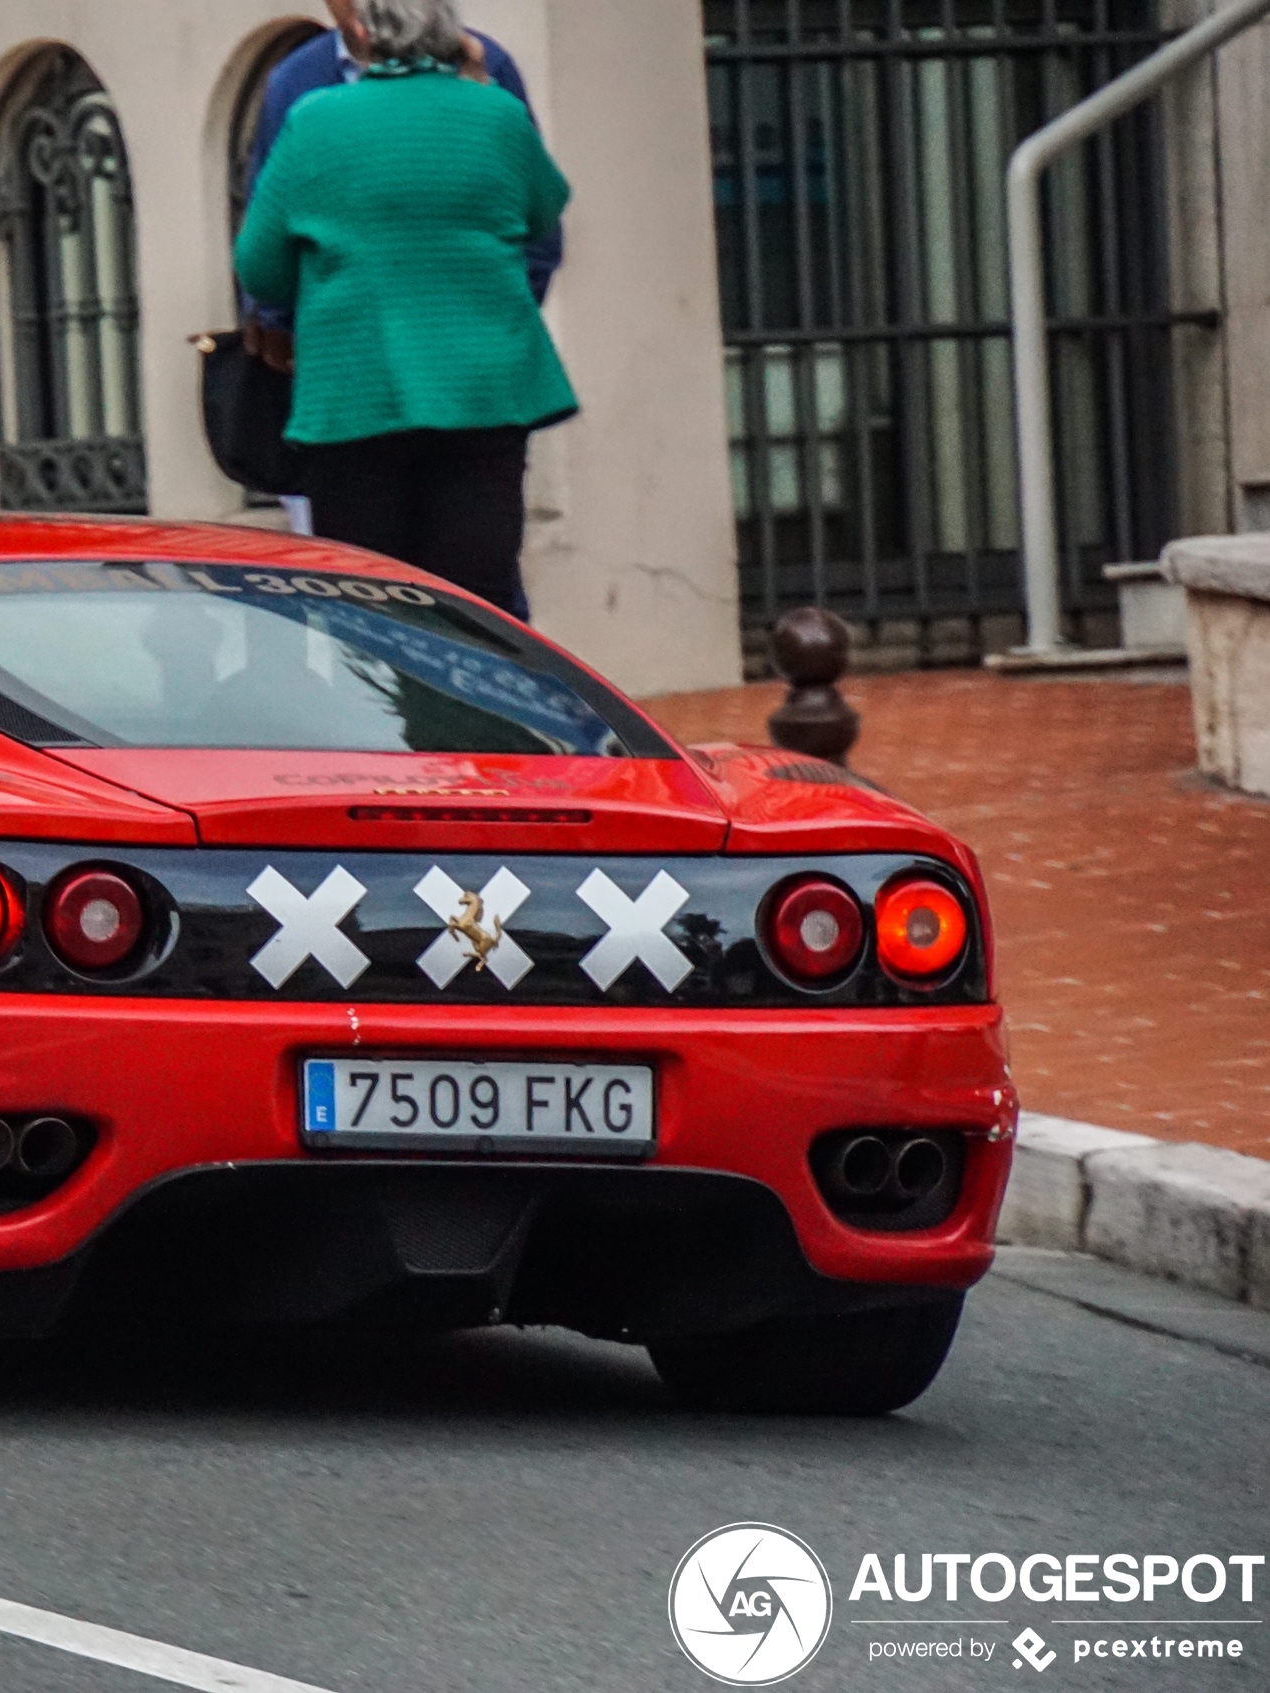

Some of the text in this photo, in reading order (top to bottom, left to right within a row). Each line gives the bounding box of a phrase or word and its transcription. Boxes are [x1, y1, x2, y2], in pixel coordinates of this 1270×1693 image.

[243, 574, 436, 607] 3000
[316, 1106, 327, 1122] E
[349, 1072, 634, 1135] 7509 FKG
